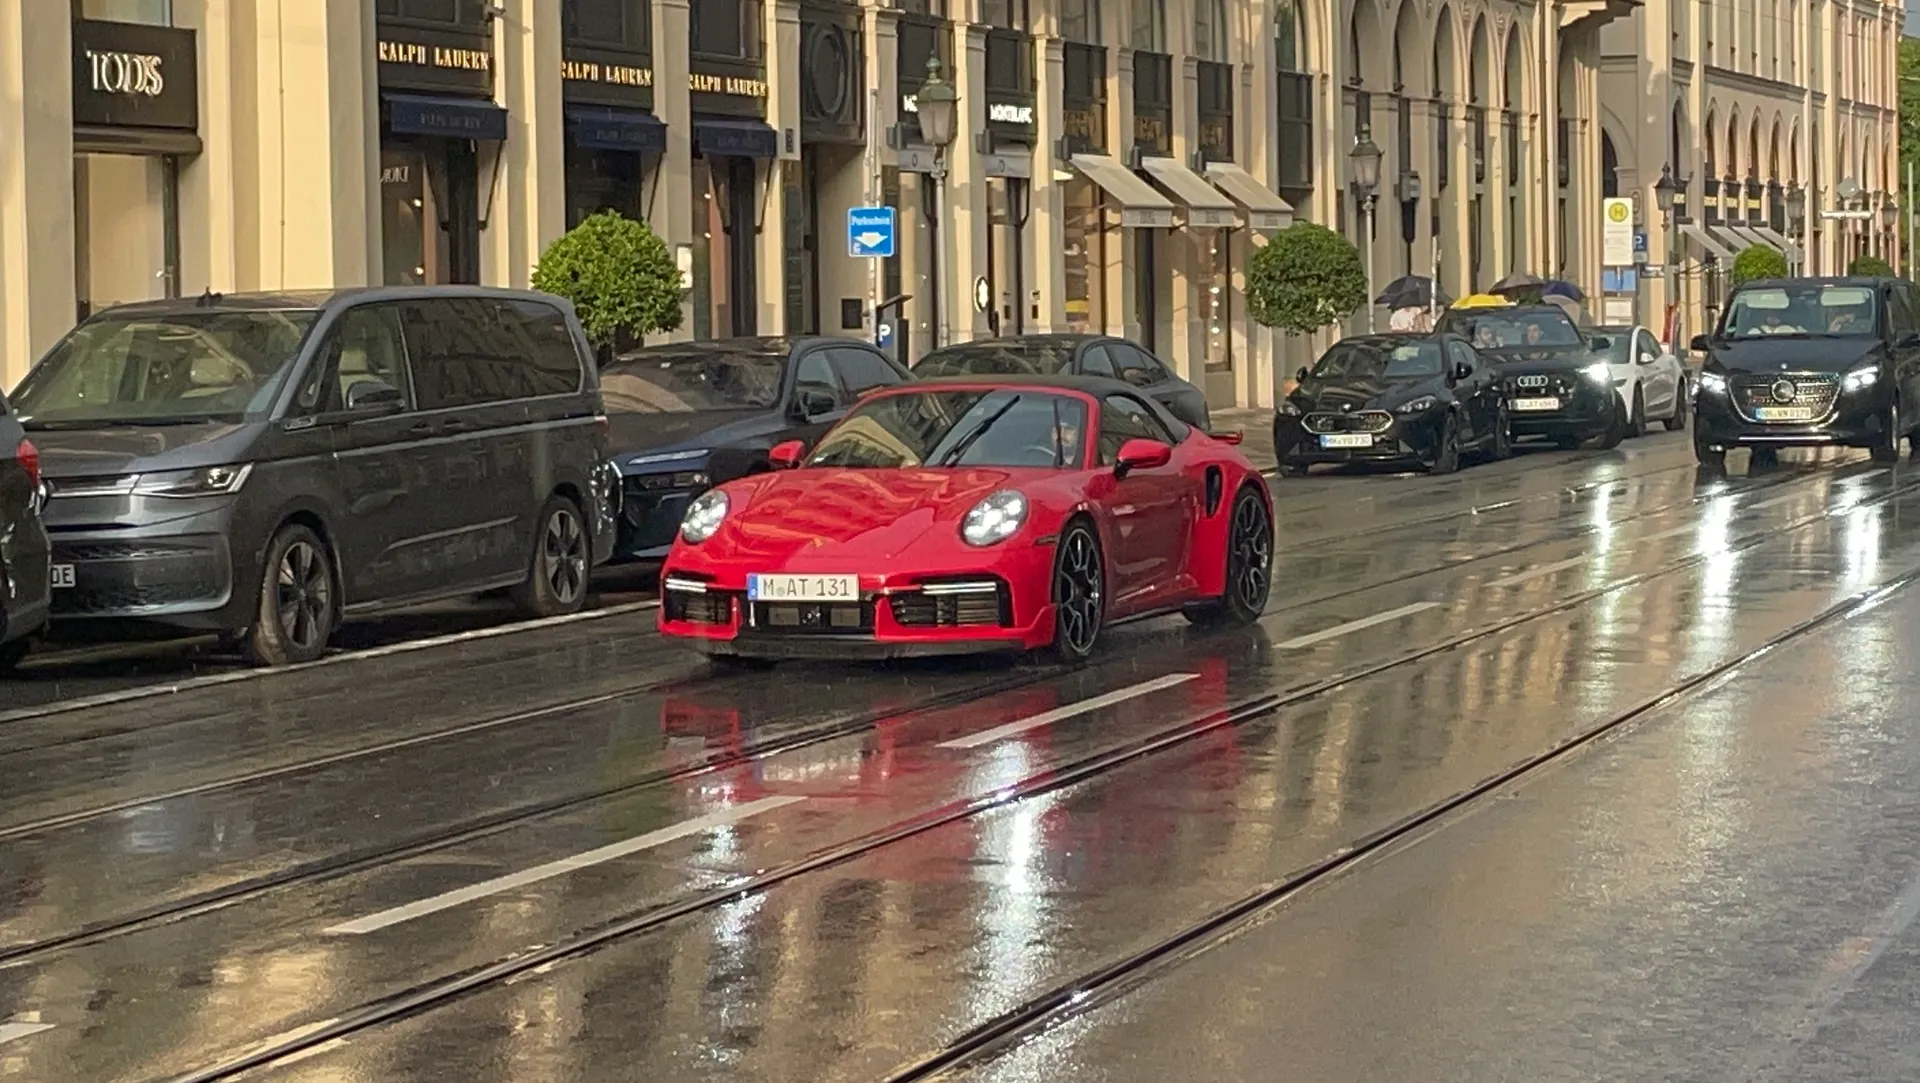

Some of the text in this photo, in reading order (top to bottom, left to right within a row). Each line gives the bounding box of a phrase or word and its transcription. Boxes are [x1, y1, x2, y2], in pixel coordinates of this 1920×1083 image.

[379, 41, 489, 71] RALPH LAUREN
[605, 65, 653, 87] LAUREN
[726, 76, 767, 97] LAUREN
[1614, 207, 1624, 217] H
[878, 323, 891, 342] P
[763, 578, 850, 596] M AT 131
